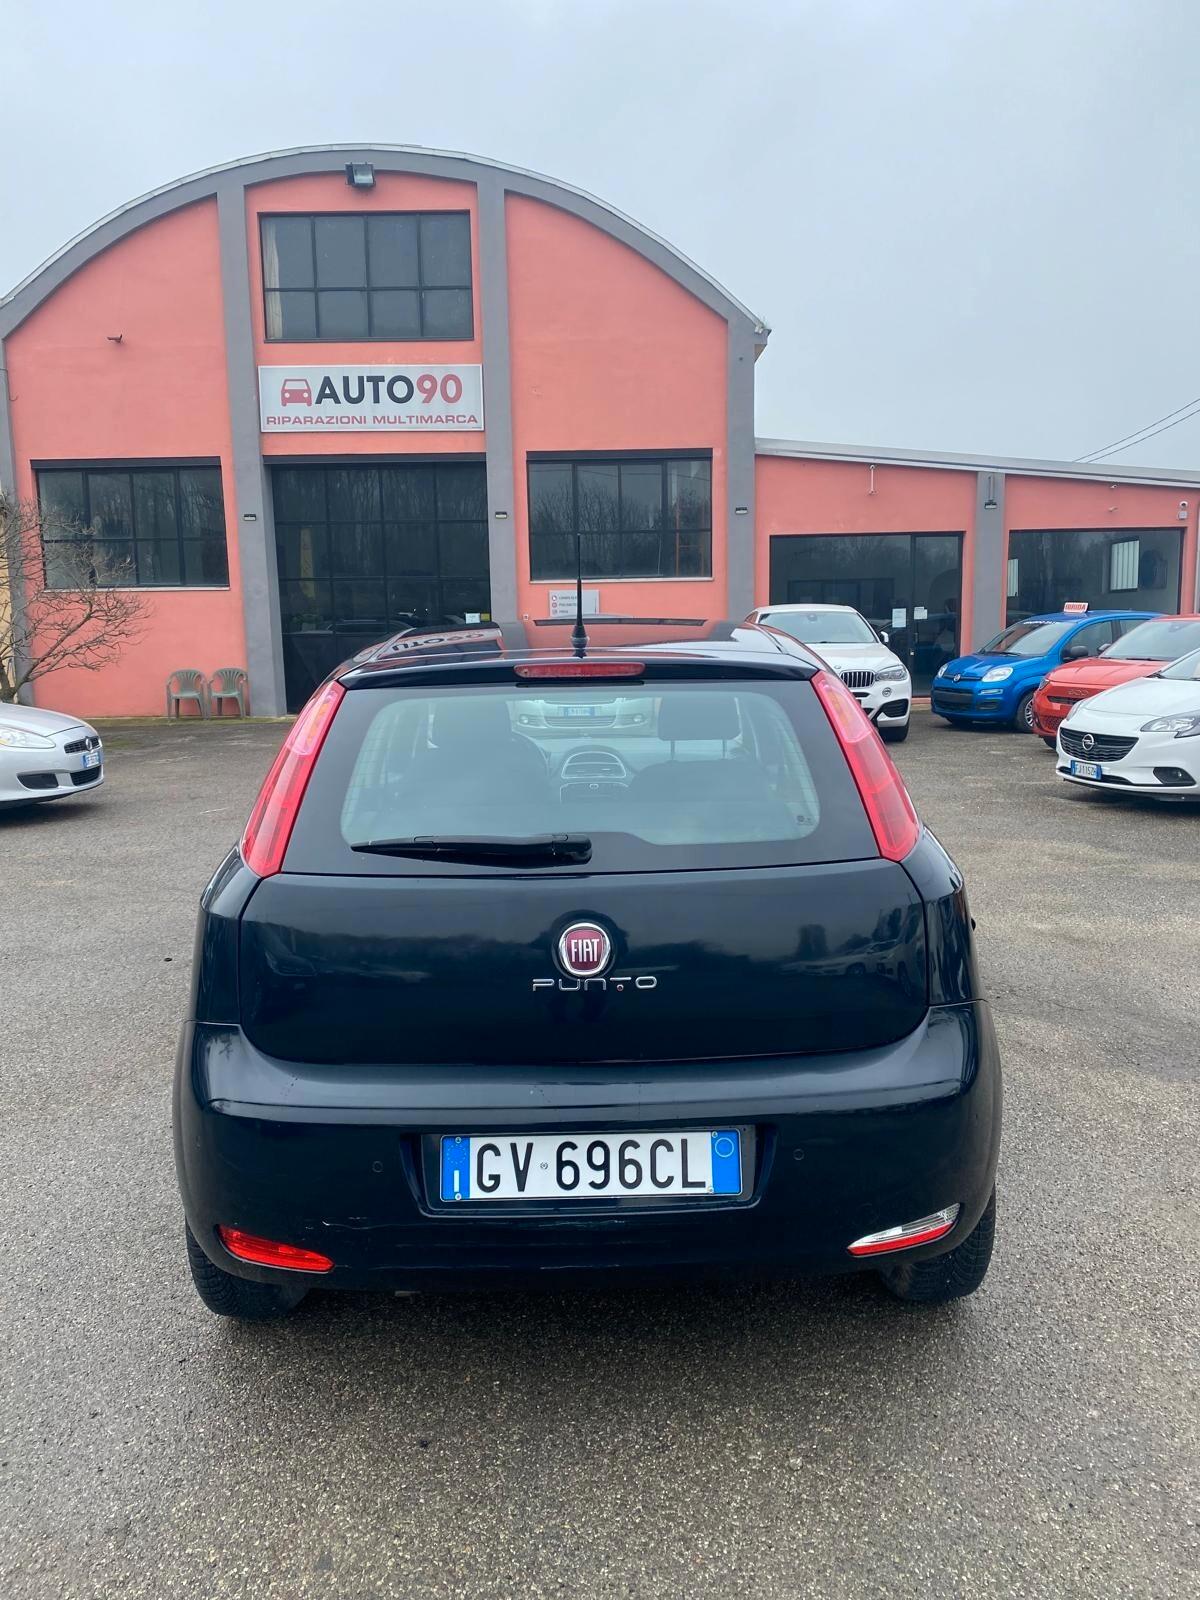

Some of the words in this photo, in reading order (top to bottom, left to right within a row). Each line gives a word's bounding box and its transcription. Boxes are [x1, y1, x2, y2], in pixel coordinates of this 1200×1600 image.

[315, 374, 463, 405] AUTO90
[266, 415, 367, 425] RIPARAZIONI
[372, 414, 478, 424] MULTIMARCA
[571, 938, 600, 962] FIAT
[532, 976, 658, 991] PUNTO
[476, 1142, 534, 1193] GV
[556, 1138, 706, 1190] 696CL
